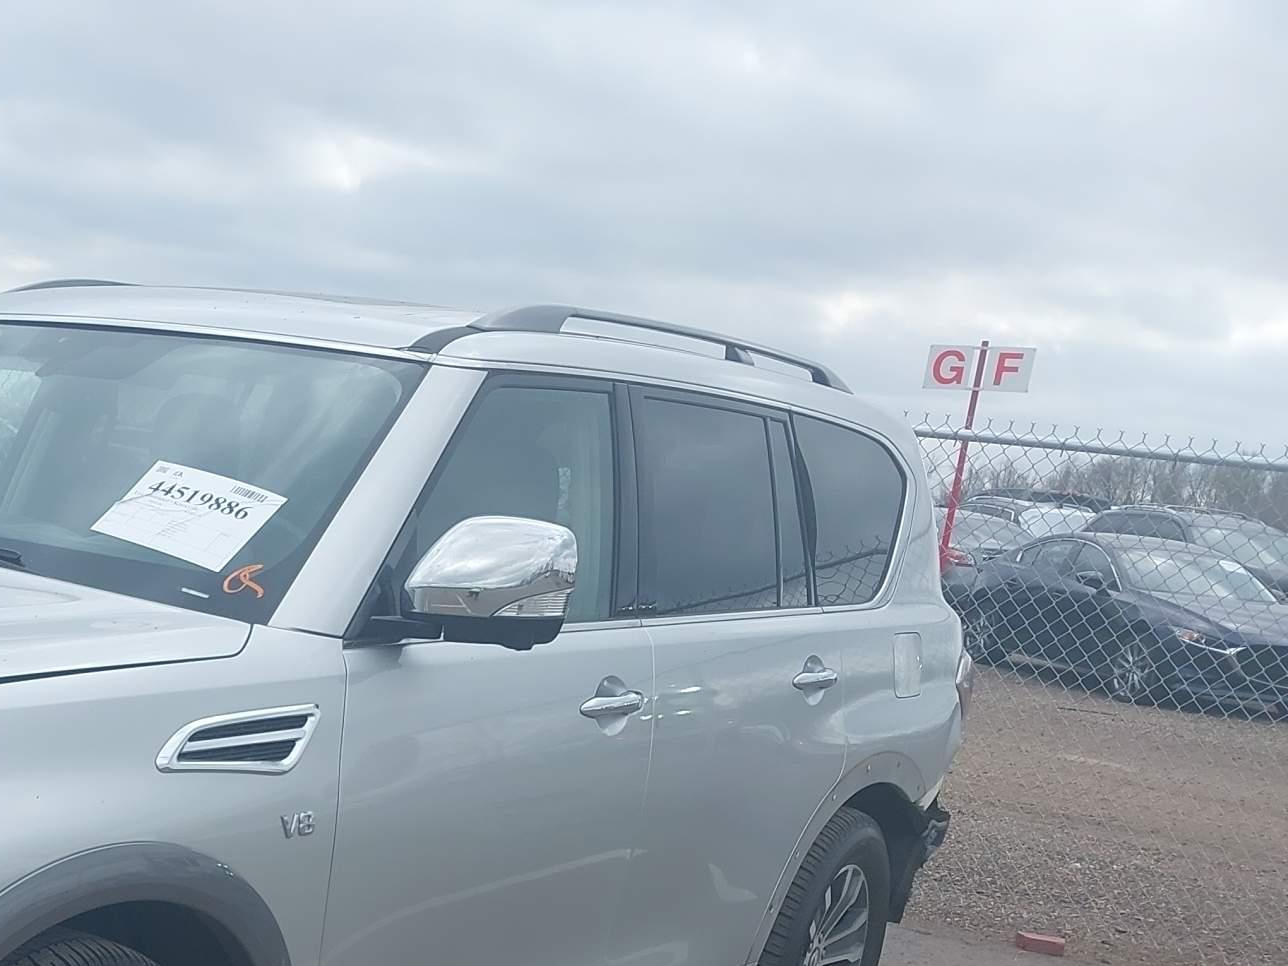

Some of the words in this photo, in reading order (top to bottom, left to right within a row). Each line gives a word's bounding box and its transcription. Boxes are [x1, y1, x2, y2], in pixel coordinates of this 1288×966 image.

[932, 349, 965, 385] G
[993, 352, 1025, 386] F
[148, 480, 253, 520] 44519886
[280, 811, 315, 839] V8
